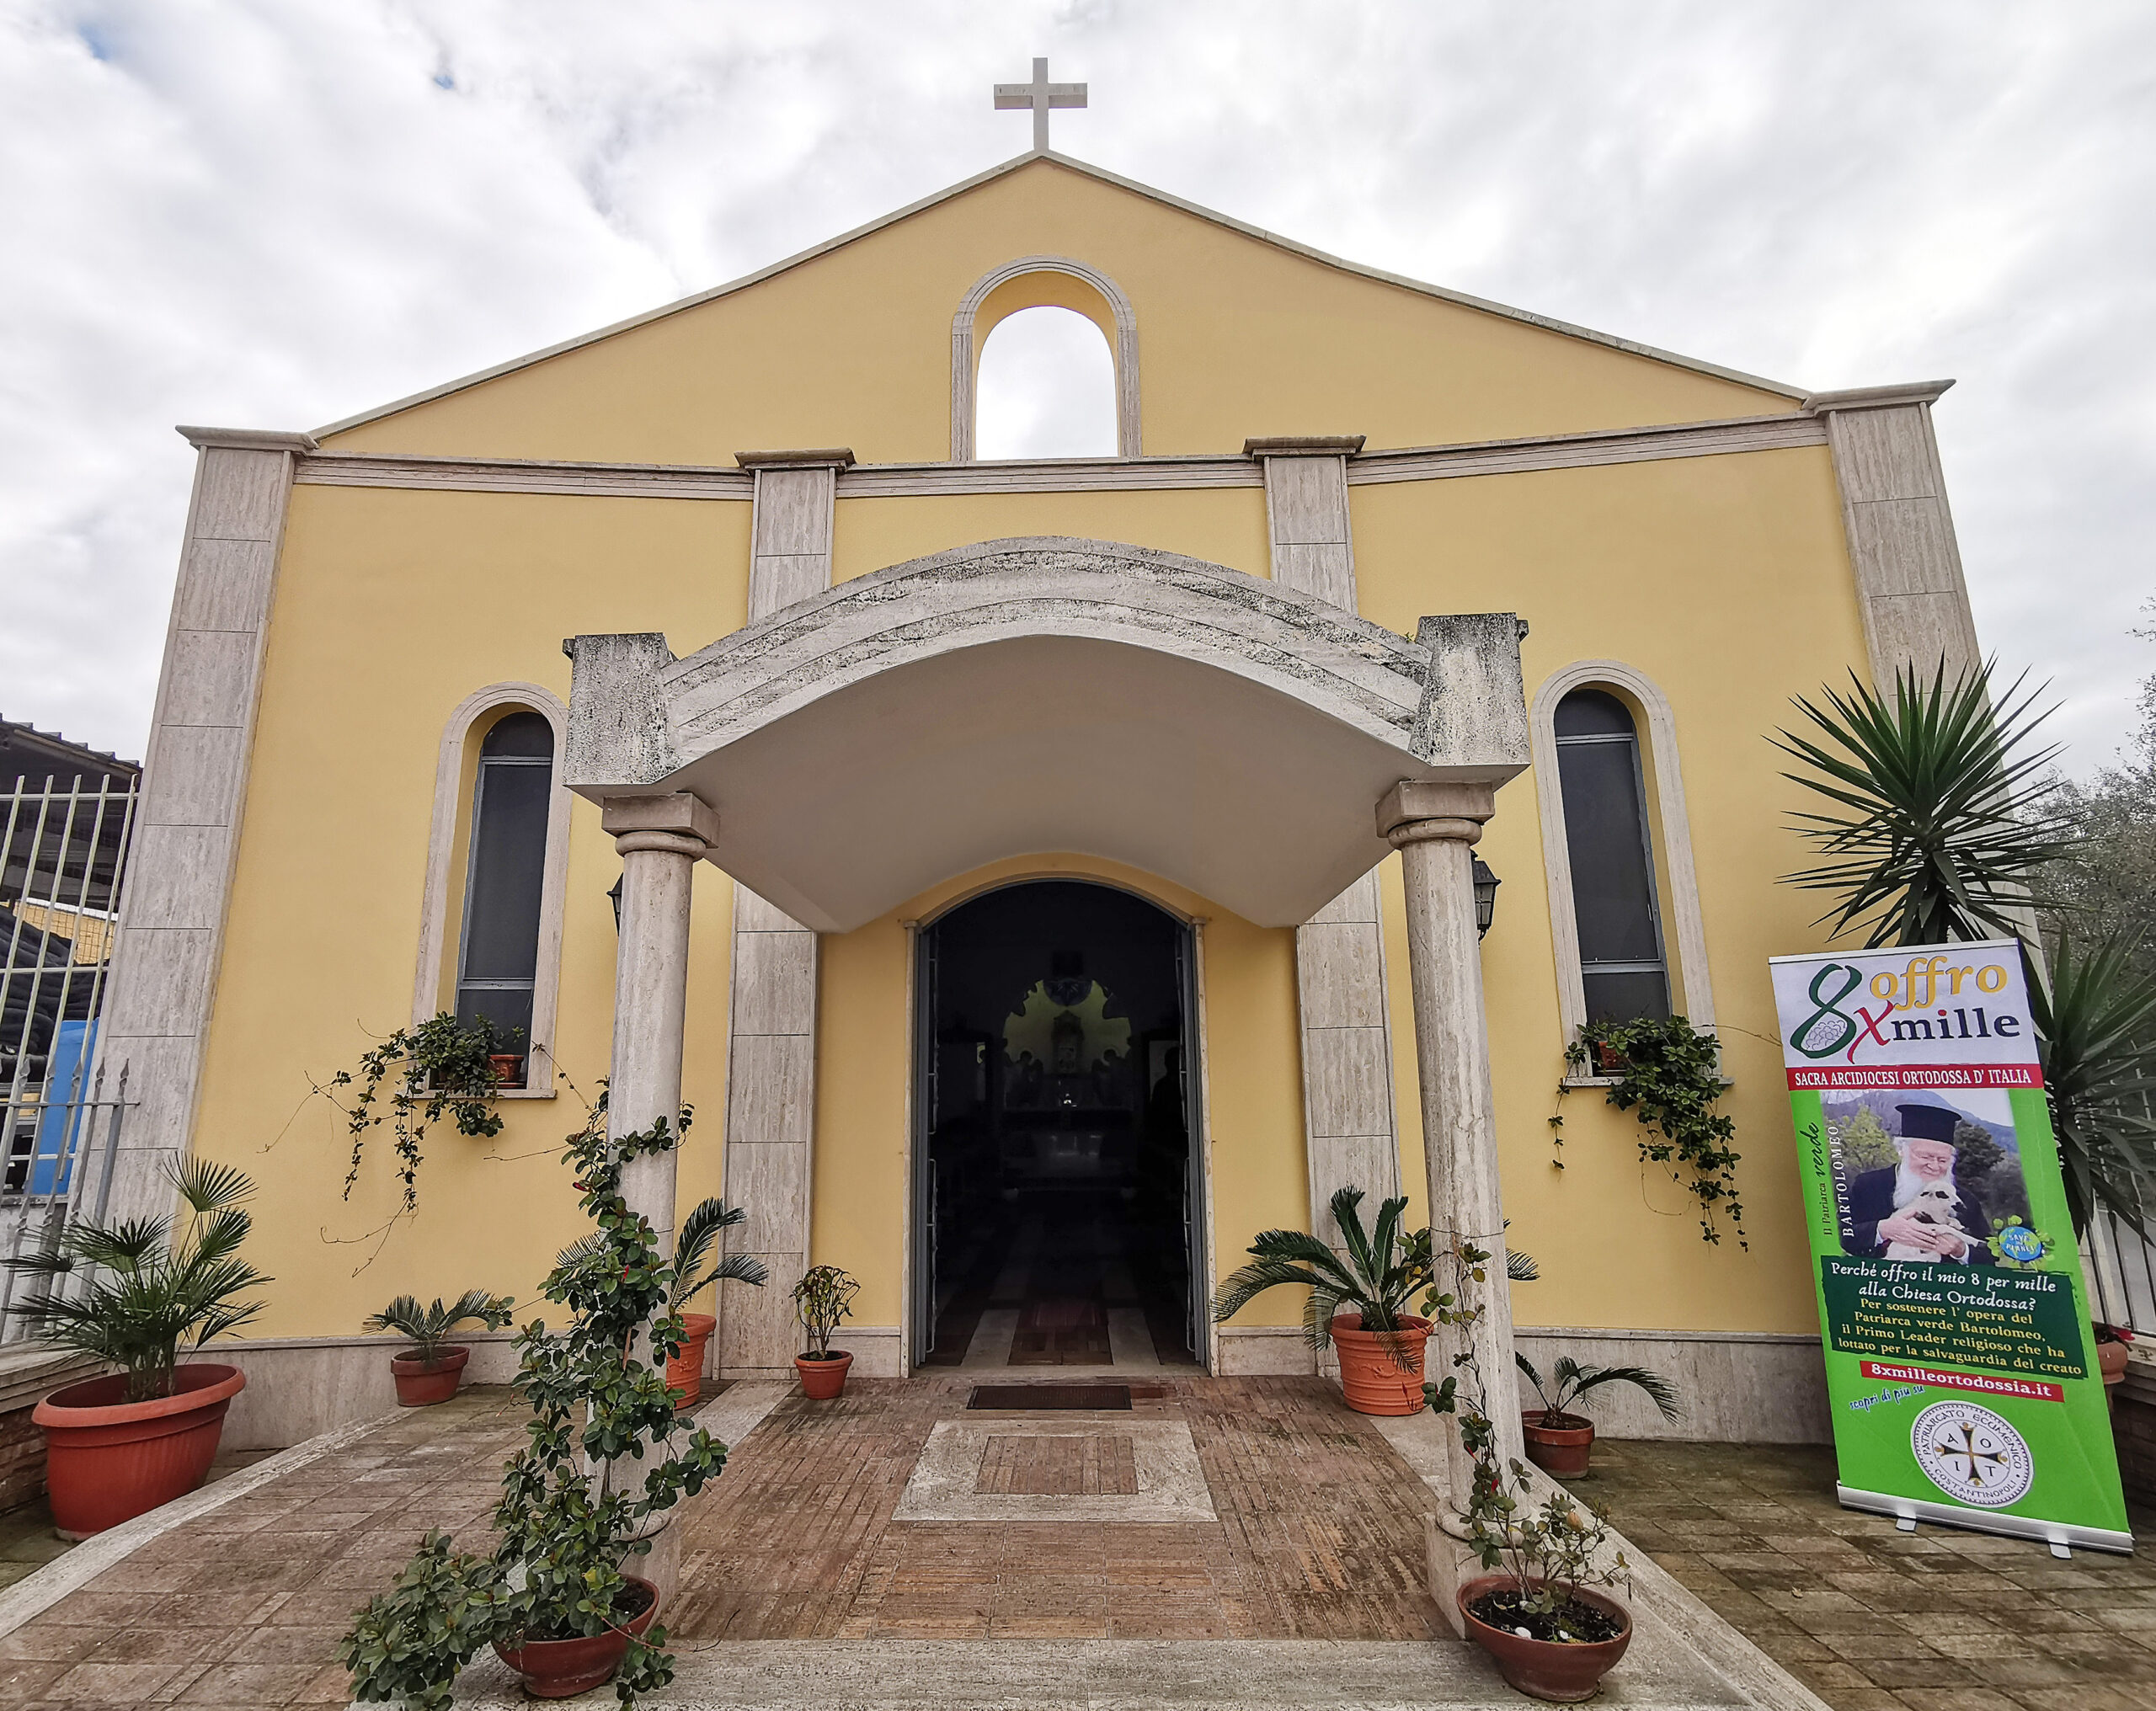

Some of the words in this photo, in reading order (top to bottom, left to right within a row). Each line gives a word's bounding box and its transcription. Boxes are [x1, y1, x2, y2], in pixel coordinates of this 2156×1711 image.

[1870, 956, 2008, 1010] offro
[1795, 1072, 1827, 1085] SACRA
[1831, 1071, 1898, 1085] ARCIDIOCESI
[1903, 1070, 1972, 1085] ORTODOSSA
[1988, 1069, 2031, 1084] ITALIA
[1800, 1122, 1826, 1177] verde
[1828, 1127, 1854, 1237] BARTOLOMEO
[1819, 1183, 1831, 1223] Patriarca
[1831, 1261, 1877, 1277] Perché
[1881, 1263, 1917, 1282] offro
[1922, 1266, 1933, 1281] il
[1937, 1271, 1966, 1284] mio
[1971, 1273, 1980, 1286] 8
[1986, 1277, 2009, 1292] per
[2015, 1276, 2057, 1293] mille
[1859, 1281, 1886, 1296] alla
[1892, 1284, 1942, 1302] Chiesa
[1947, 1291, 2036, 1311] Ortodossa?
[1860, 1298, 1881, 1309] Per
[1886, 1303, 1946, 1315] sostenere
[1967, 1309, 2005, 1322] opera
[2011, 1314, 2033, 1325] del
[1842, 1324, 1850, 1334] il
[1855, 1325, 1895, 1339] Primo
[1901, 1330, 1946, 1345] Leader
[1952, 1337, 2012, 1351] religioso
[2017, 1343, 2041, 1356] che
[2047, 1346, 2066, 1358] ha
[1854, 1311, 1911, 1326] Patriarca
[1916, 1319, 1954, 1331] verde
[1961, 1322, 2046, 1342] Bartolomeo,
[1838, 1337, 1876, 1351] lottato
[1881, 1344, 1901, 1355] per
[1907, 1345, 1918, 1356] la
[1923, 1347, 2008, 1366] salvaguardia
[2014, 1357, 2034, 1369] del
[2040, 1363, 2082, 1375] creato
[1871, 1364, 2052, 1397] 8xmilleortodossia.it
[1849, 1395, 1878, 1412] scopri
[1881, 1389, 1891, 1402] di
[1913, 1385, 1924, 1394] su
[1921, 1410, 1965, 1456] PATRIARCATO
[1972, 1414, 2022, 1469] ECUMENICO
[1947, 1433, 1959, 1444] A
[1935, 1468, 2017, 1499] COSTANTINOPOLI
[1984, 1465, 1996, 1477] T
